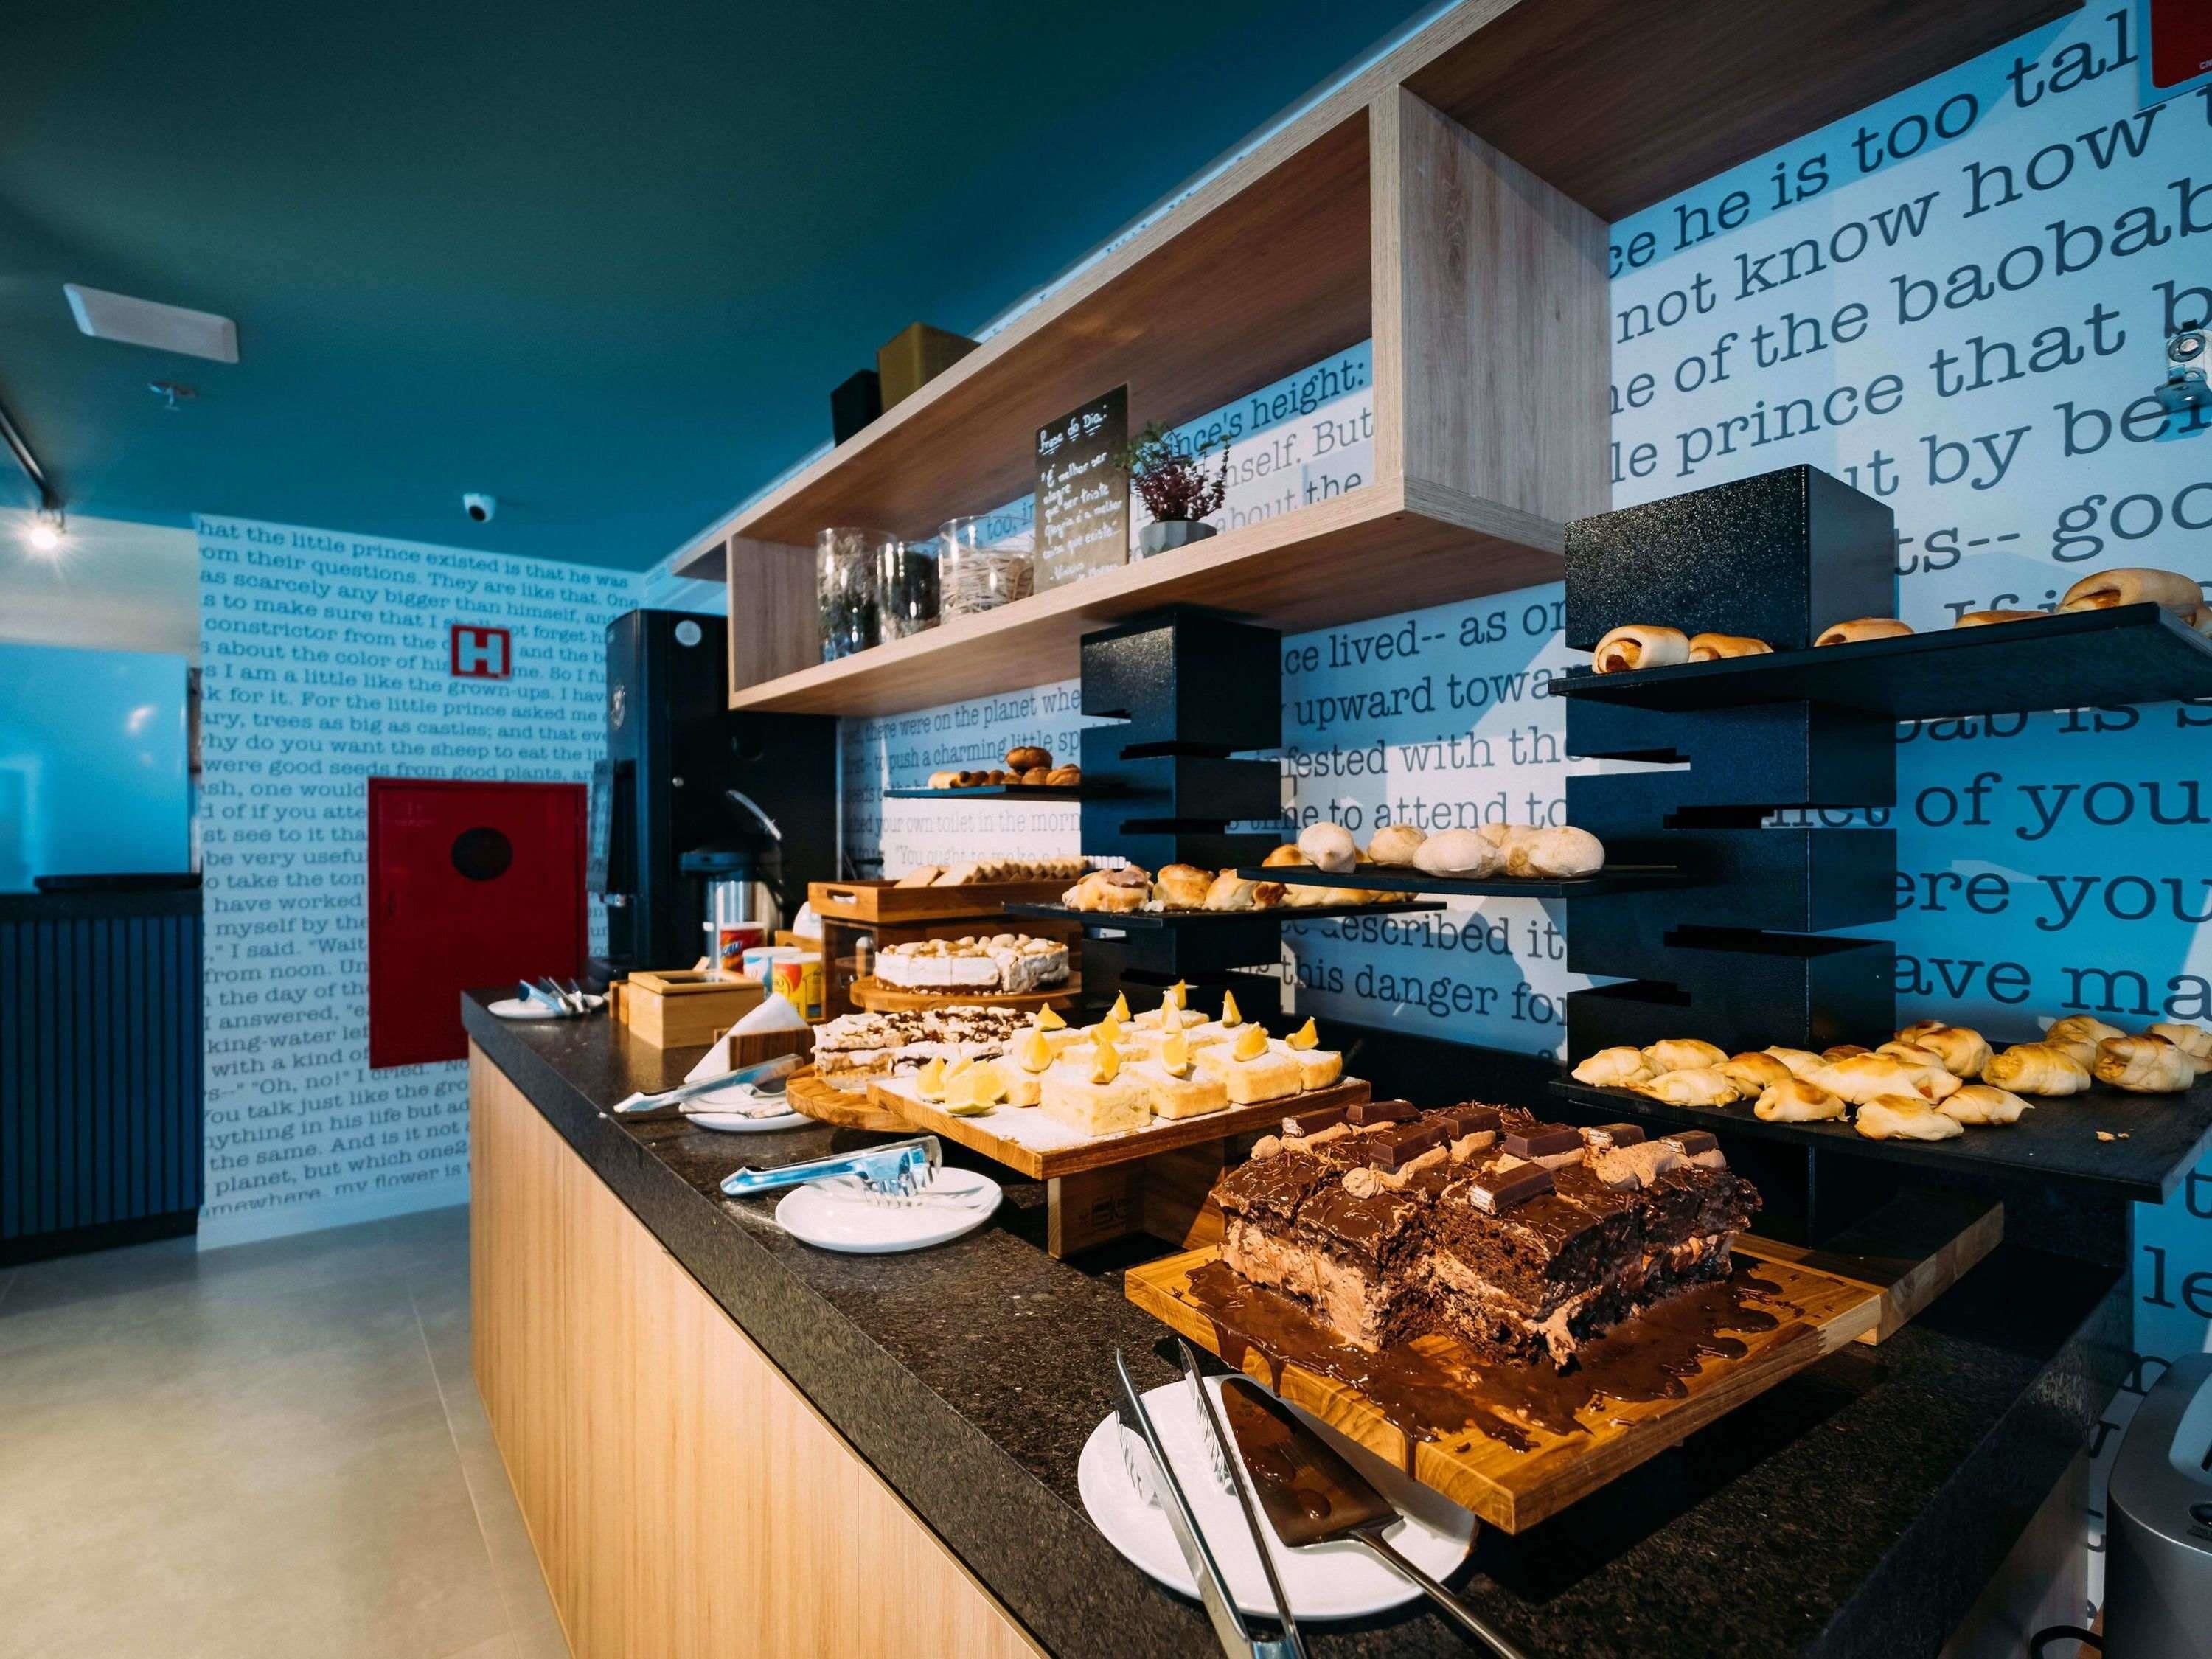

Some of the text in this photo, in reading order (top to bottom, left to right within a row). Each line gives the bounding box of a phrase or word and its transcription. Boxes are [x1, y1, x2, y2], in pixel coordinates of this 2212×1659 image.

[1674, 8, 2138, 251] he is too tal
[1617, 104, 2166, 344] not know how
[1674, 332, 1738, 392] of
[1750, 302, 1868, 369] the
[1251, 358, 1364, 431] height:
[1676, 374, 1904, 477] prince
[1929, 303, 2125, 397] that
[1312, 406, 1374, 457] But
[1919, 425, 2032, 490] by
[246, 524, 628, 588] the little prince existed that he was
[233, 572, 580, 624] scarcely any bigger than himself,
[247, 551, 639, 607] their They are like One
[204, 617, 588, 662] constrictor from the and the
[254, 598, 317, 616] make
[323, 605, 373, 622] sure
[380, 609, 425, 627] that
[533, 625, 587, 644] forget
[1328, 611, 1507, 667] lived-- as
[217, 639, 391, 666] about the color
[240, 667, 442, 692] am little like the
[230, 687, 597, 721] for For the little prince asked me
[900, 718, 931, 735] were
[934, 714, 951, 730] on
[955, 706, 979, 727] the
[984, 695, 1037, 728] planet
[1294, 676, 1435, 731] upward
[253, 712, 577, 740] trees as big as and that
[245, 734, 582, 761] do you want the sheep eat the
[889, 751, 919, 774] push
[922, 754, 931, 766] a
[933, 737, 1007, 764] charming
[1399, 731, 1495, 772] with
[204, 759, 496, 779] were good seeds good
[250, 782, 366, 797] one would
[1916, 771, 2211, 841] of you
[274, 807, 316, 822] you
[998, 810, 1026, 832] the
[1328, 799, 1363, 832] to
[1374, 791, 1509, 831] attend
[233, 830, 271, 843] see
[241, 853, 295, 867] very
[227, 872, 324, 888] take the
[214, 894, 362, 913] have worked
[216, 917, 329, 938] myself by
[1528, 920, 1564, 960] it
[204, 967, 262, 984] from
[1280, 955, 1344, 994] this
[1355, 964, 1498, 1018] danger
[219, 987, 307, 1006] the day
[212, 1049, 343, 1077] with kind
[248, 1085, 429, 1119] talk just like the
[330, 1104, 441, 1130] his life but
[210, 1121, 459, 1171] the And not
[305, 1150, 412, 1180] but which
